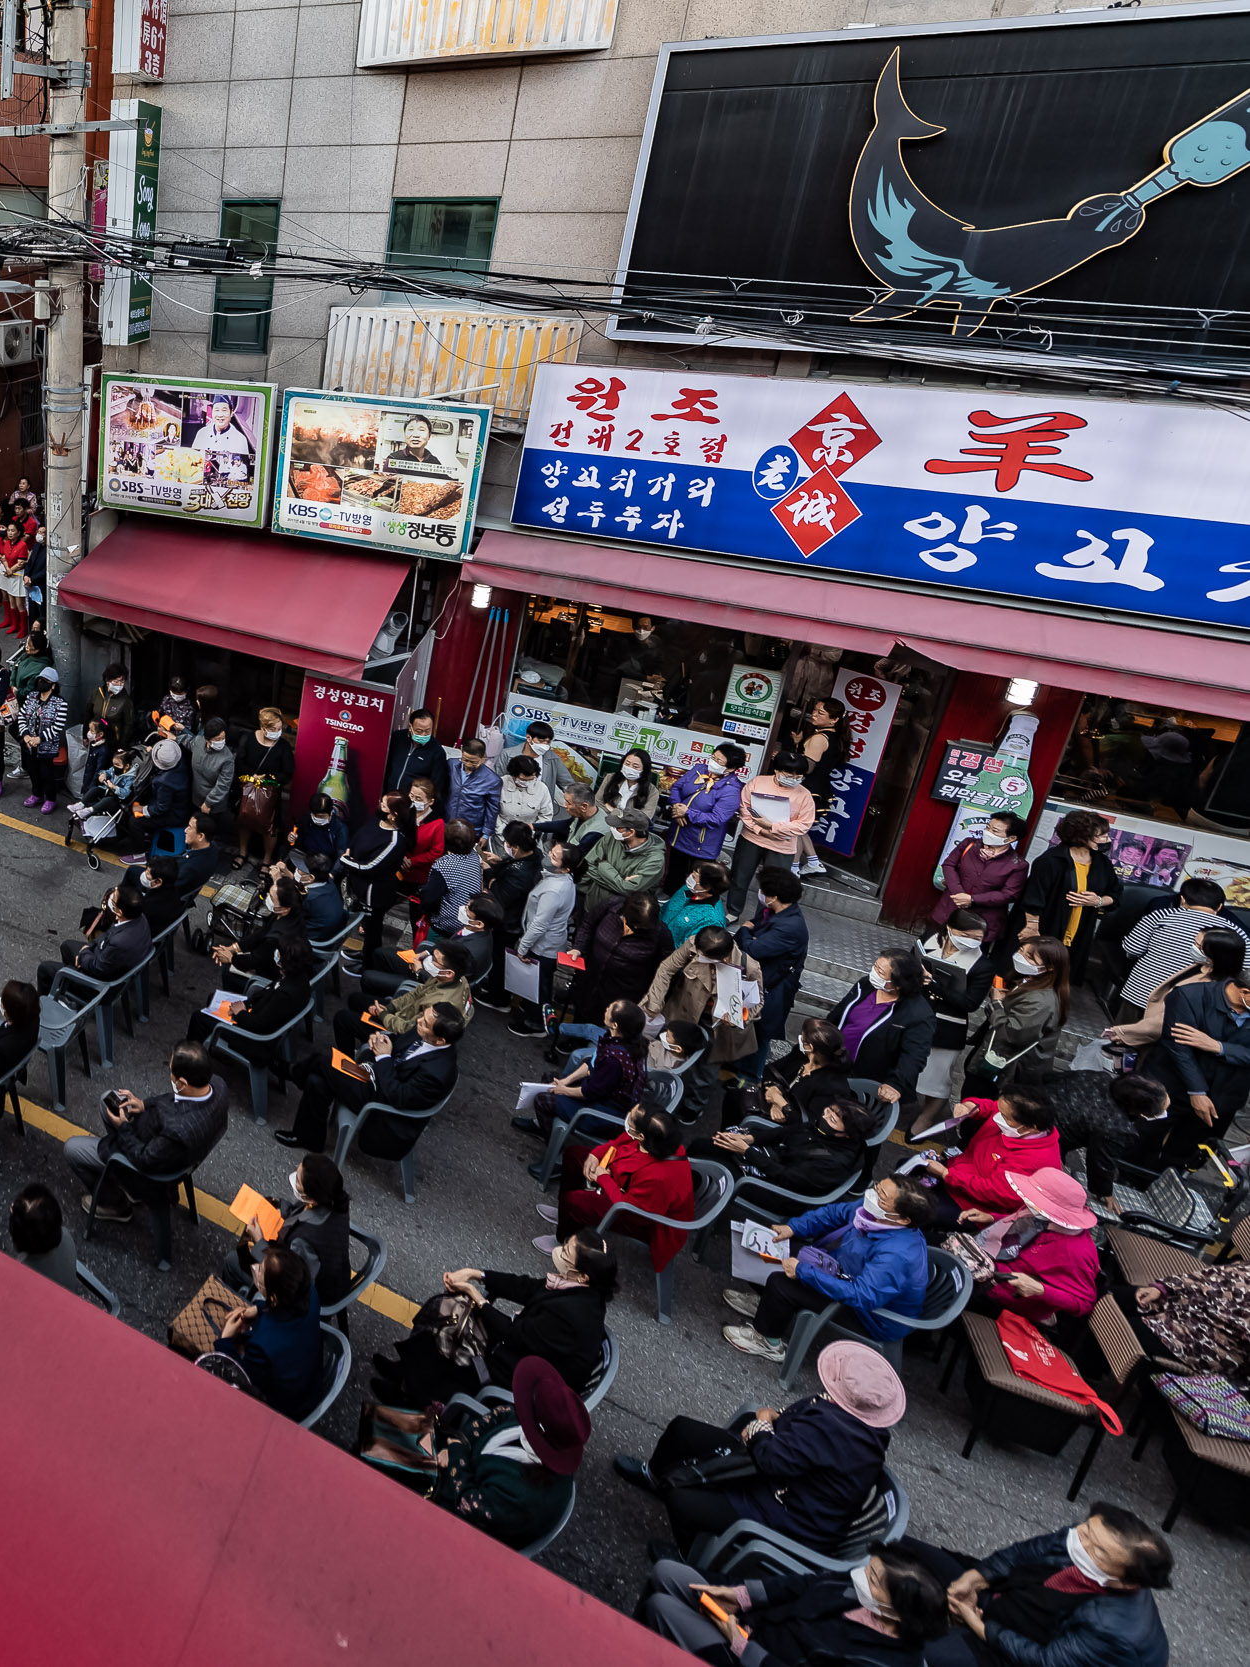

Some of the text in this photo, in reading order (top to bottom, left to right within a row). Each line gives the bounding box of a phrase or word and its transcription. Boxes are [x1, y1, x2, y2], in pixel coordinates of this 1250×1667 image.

[567, 376, 722, 424] 원조
[549, 420, 730, 464] 건대2호점
[806, 412, 859, 466] 京
[923, 409, 1095, 493] 羊
[539, 460, 716, 508] 양꼬치거리
[756, 458, 788, 492] 老
[288, 503, 318, 518] KBS
[541, 496, 686, 540] 선두주자
[313, 685, 385, 713] 경성양꼬치
[848, 682, 882, 703] 원조
[324, 717, 365, 733] TSINGTAO
[609, 727, 678, 757] 투데이
[960, 751, 1005, 774] 경성
[943, 769, 980, 787] 오늘
[938, 784, 1022, 813] 뭐먹을까?
